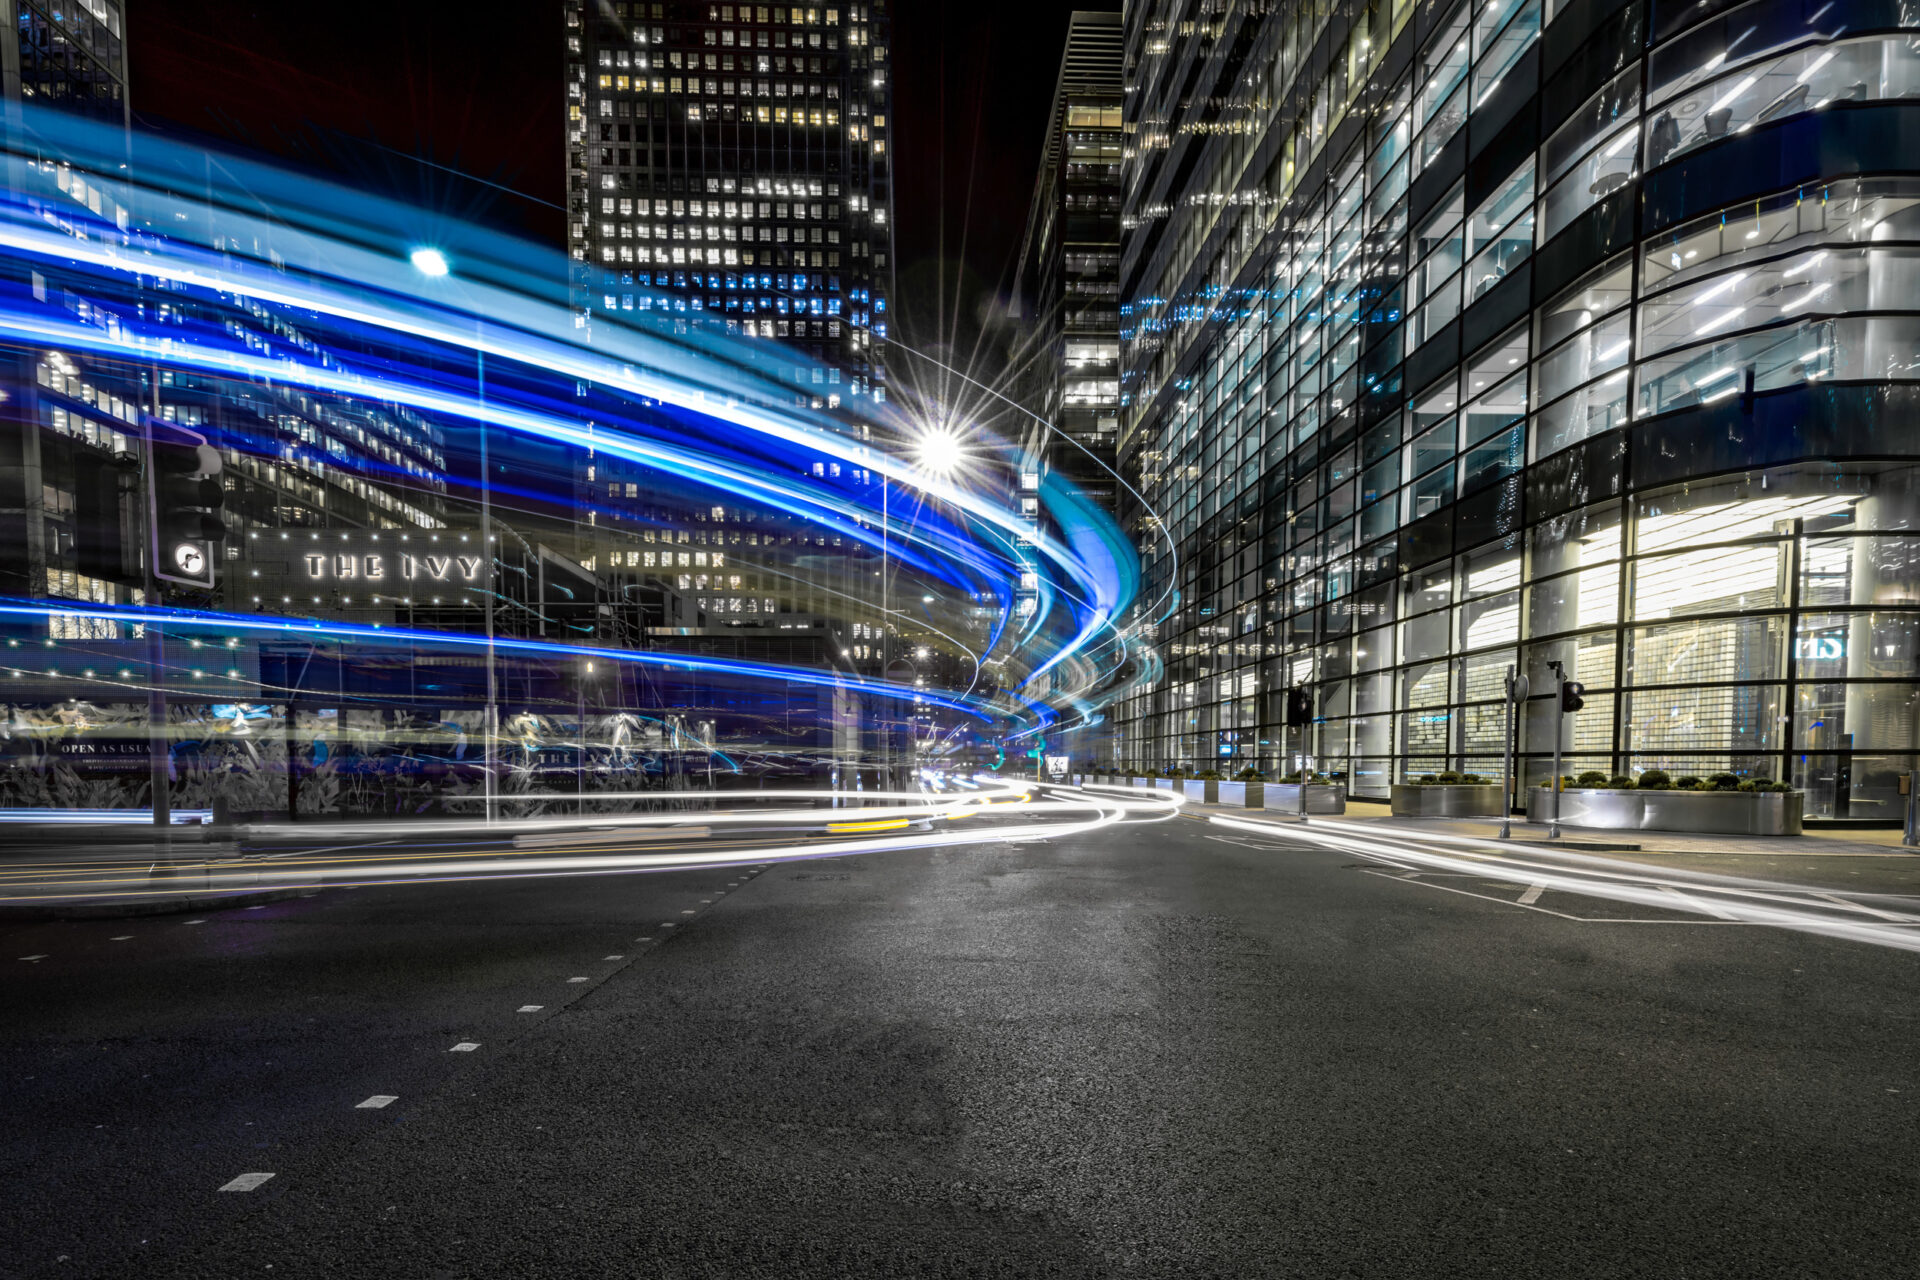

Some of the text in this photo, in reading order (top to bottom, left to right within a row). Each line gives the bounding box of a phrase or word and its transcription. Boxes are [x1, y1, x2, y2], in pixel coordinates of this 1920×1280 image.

[304, 554, 480, 579] THE IVY
[61, 744, 152, 753] OPEN AS USUA
[538, 753, 571, 764] THE
